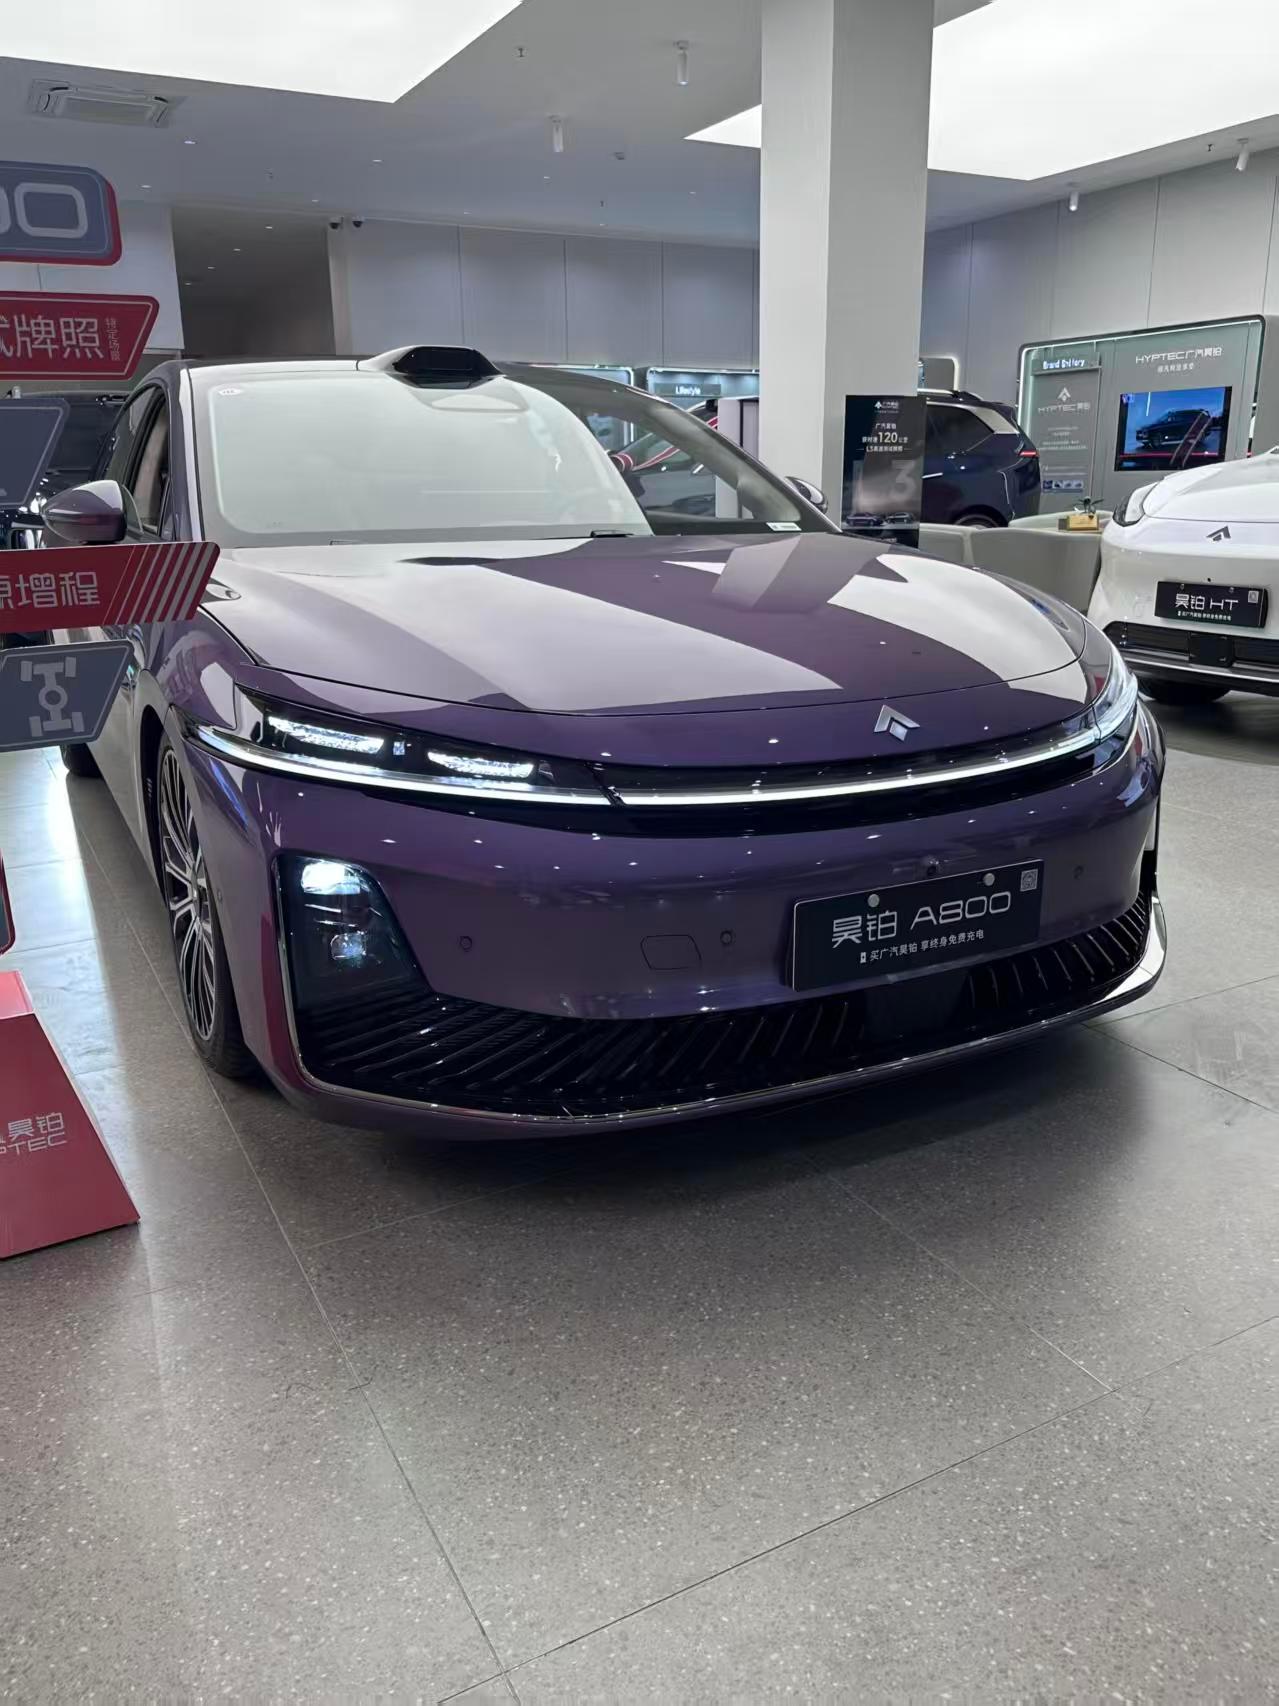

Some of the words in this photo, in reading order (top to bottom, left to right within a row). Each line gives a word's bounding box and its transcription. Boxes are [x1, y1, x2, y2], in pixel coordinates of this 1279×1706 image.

[0, 182, 88, 239] 0
[1043, 359, 1060, 370] Brand
[1061, 358, 1085, 369] Gallery
[675, 385, 701, 396] Lifestyle
[1175, 593, 1205, 610] 昊铂
[1210, 597, 1239, 611] HT
[831, 910, 898, 949] 昊铂
[910, 891, 1011, 930] A800
[869, 942, 918, 961] 买广汽昊铂
[920, 929, 985, 952] 享终身免费充电
[0, 1112, 64, 1143] 昊铂
